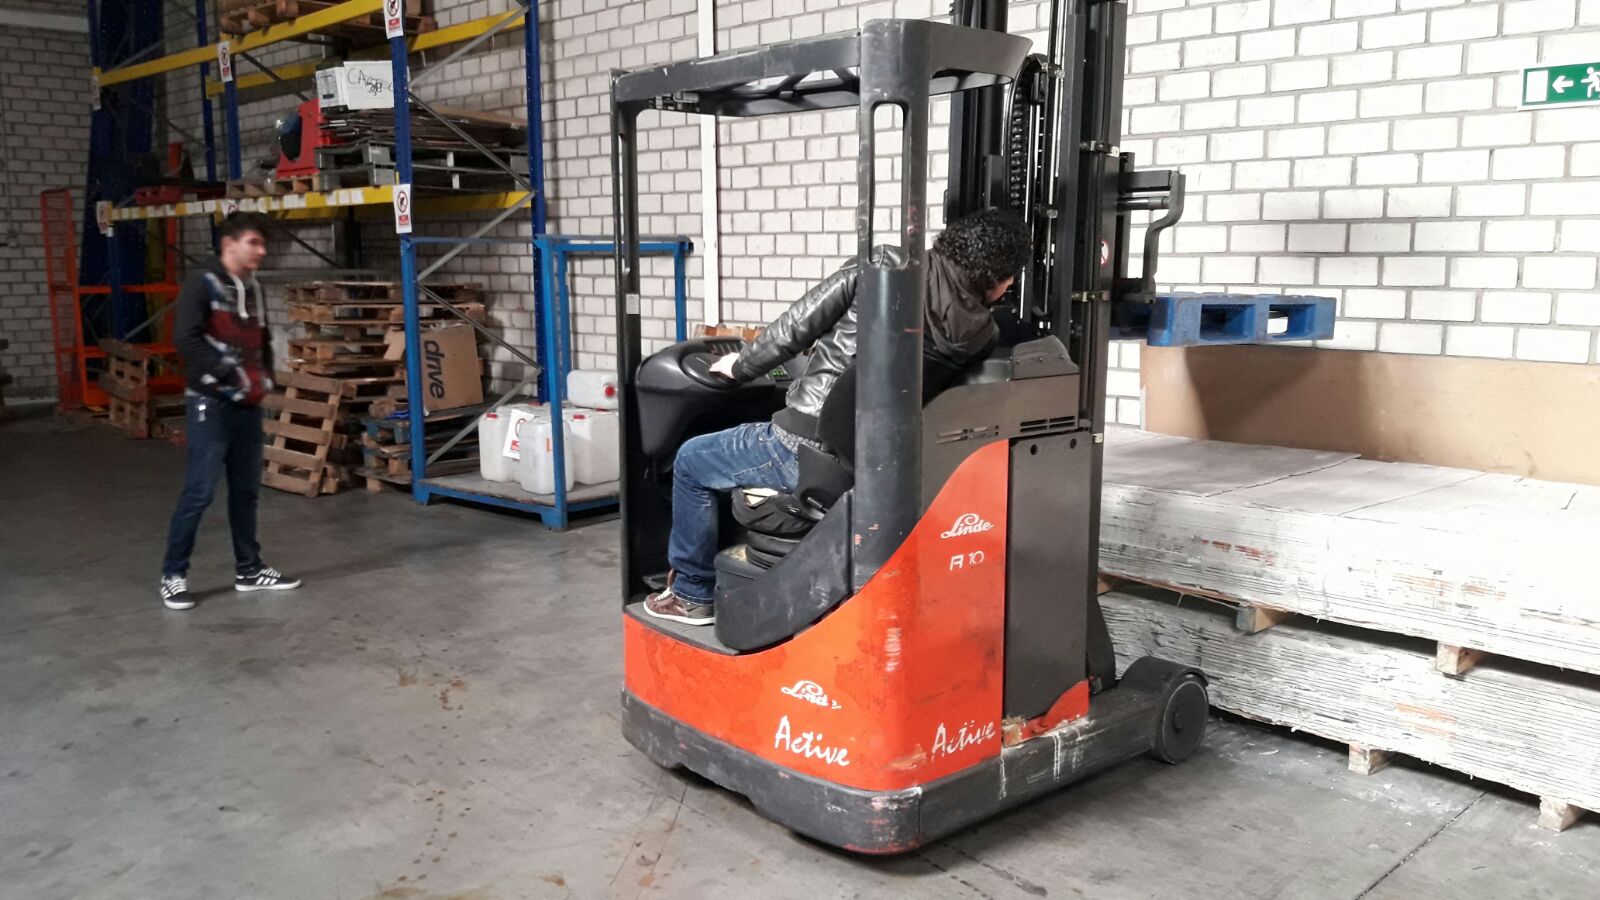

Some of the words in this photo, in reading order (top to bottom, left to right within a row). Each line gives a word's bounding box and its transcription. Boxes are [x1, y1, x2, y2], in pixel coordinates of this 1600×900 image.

[424, 340, 445, 399] drive
[940, 513, 994, 539] Linde
[968, 550, 985, 565] 10
[774, 714, 850, 766] Active
[930, 720, 996, 763] Active
